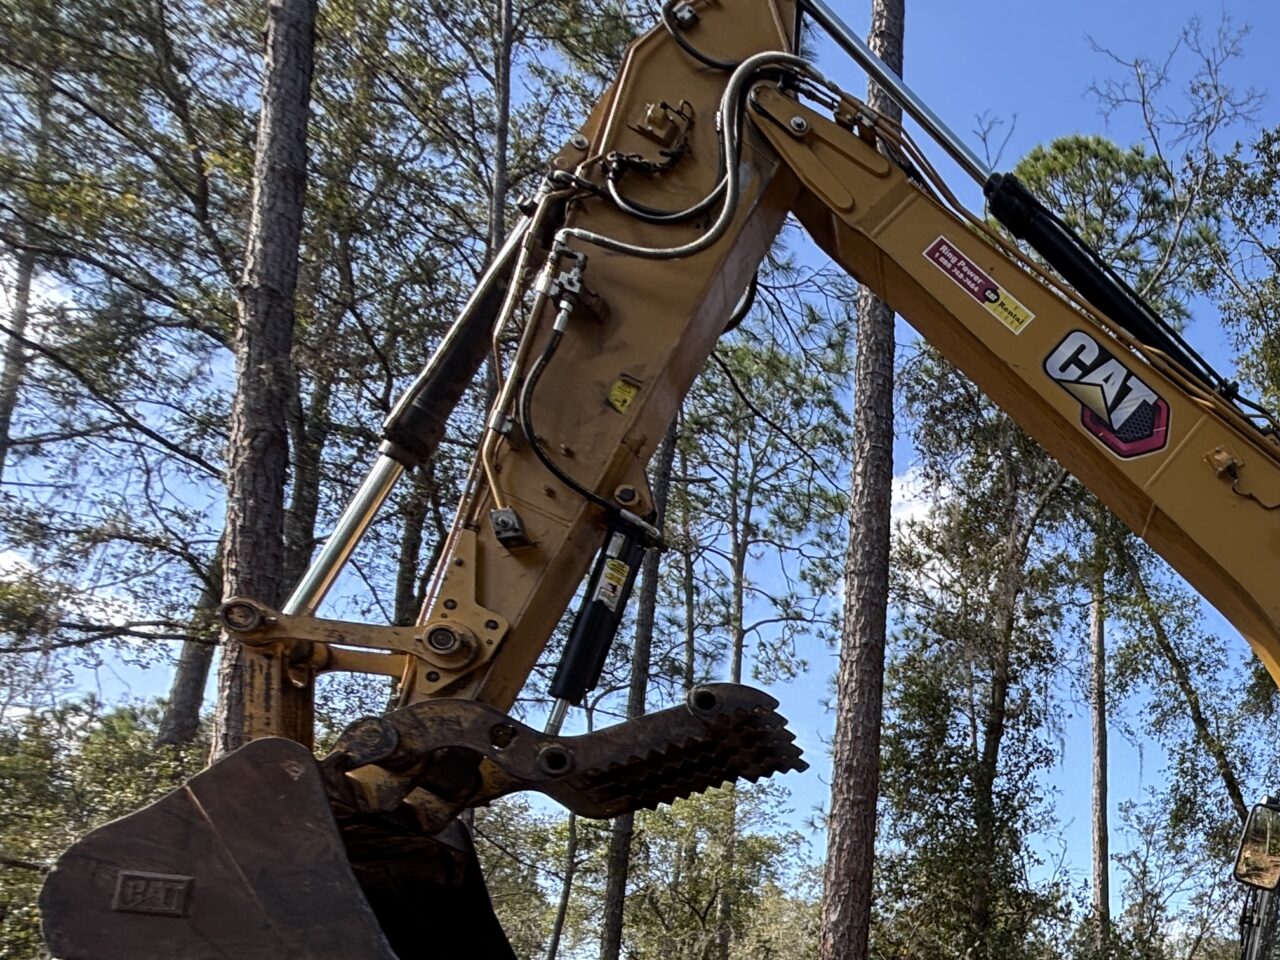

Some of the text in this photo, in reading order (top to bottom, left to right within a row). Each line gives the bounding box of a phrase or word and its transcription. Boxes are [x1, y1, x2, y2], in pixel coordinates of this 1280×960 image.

[939, 244, 983, 284] Ring Power
[998, 301, 1025, 325] Rental
[1046, 331, 1158, 431] CAT
[120, 879, 186, 911] CAT
